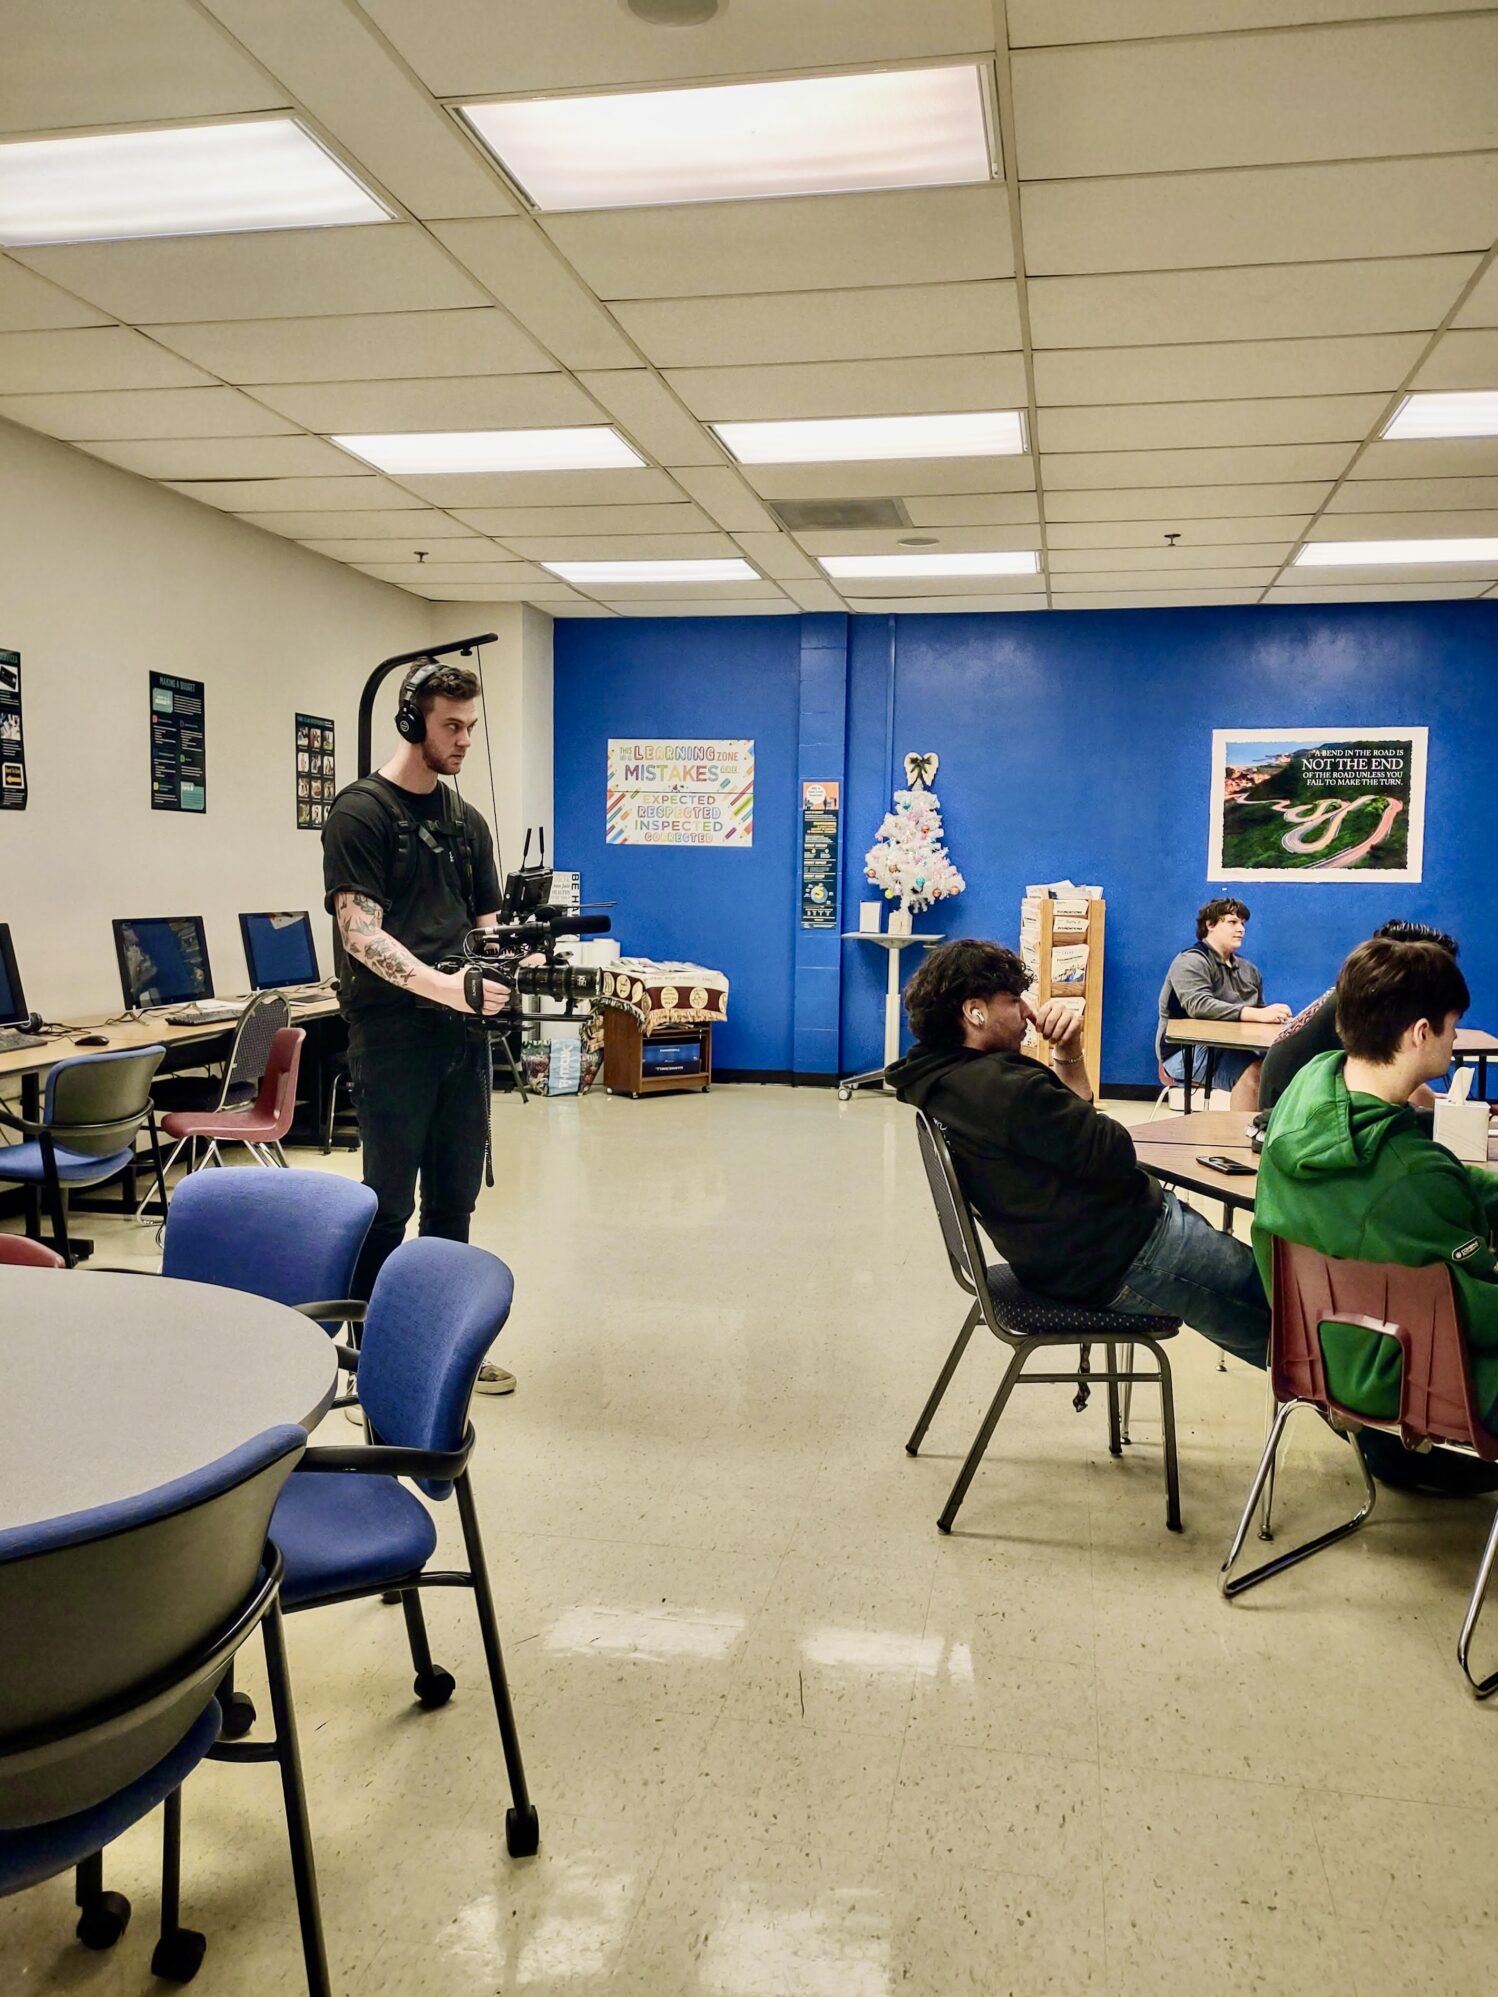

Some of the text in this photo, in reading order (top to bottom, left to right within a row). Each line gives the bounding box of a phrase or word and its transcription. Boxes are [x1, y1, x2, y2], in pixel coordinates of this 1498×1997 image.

[634, 746, 716, 761] LEARNING
[716, 752, 738, 761] ZONE
[1302, 758, 1403, 770] NOT THE END
[624, 765, 719, 782] MISTAKES
[642, 795, 716, 805] EXPECTED
[638, 806, 721, 819] RESPECTED
[634, 820, 723, 831] INSPECTED
[644, 832, 713, 843] CORRECTED
[572, 874, 579, 890] BE
